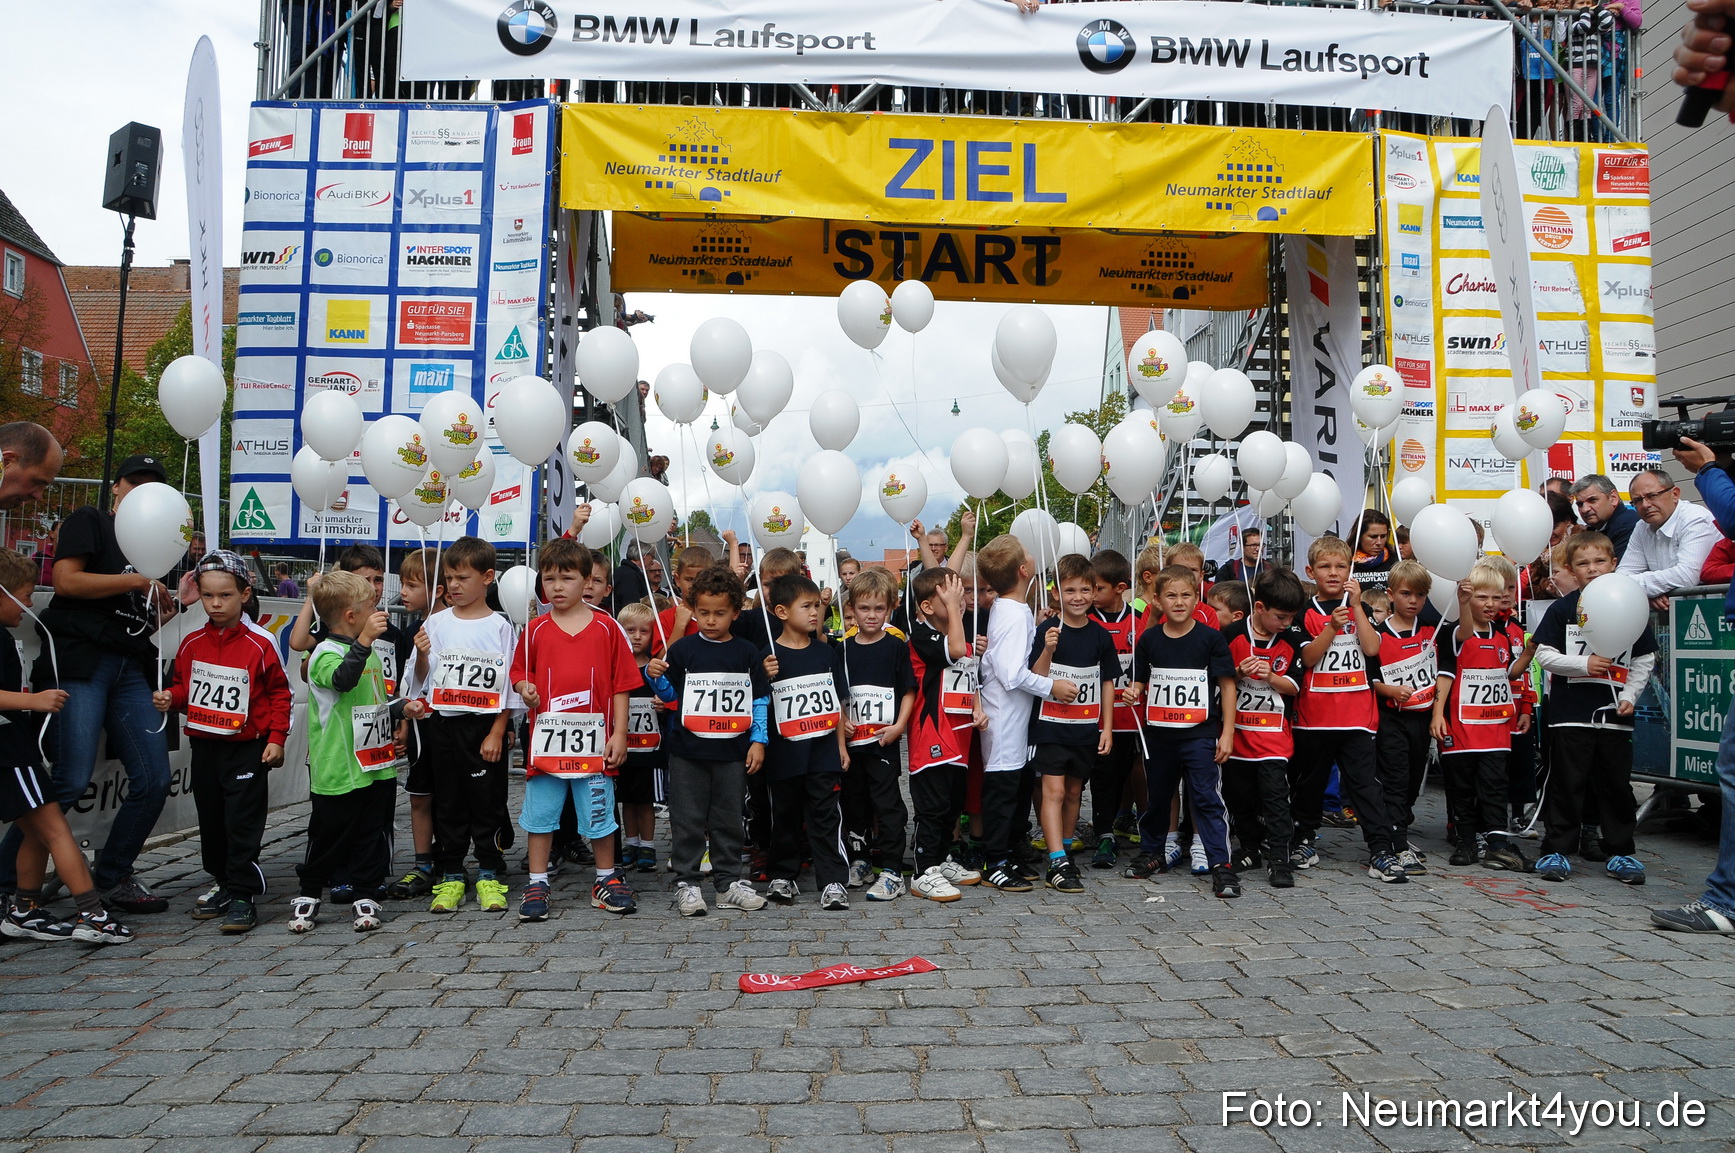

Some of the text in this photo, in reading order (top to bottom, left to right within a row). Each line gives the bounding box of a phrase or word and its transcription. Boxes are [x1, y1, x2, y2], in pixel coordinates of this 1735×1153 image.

[504, 0, 555, 21] BMW
[572, 14, 877, 56] BMW Laufsport
[1080, 20, 1130, 40] BMW
[1150, 36, 1430, 80] BMW Laufsport
[260, 140, 282, 151] DEHN
[343, 137, 371, 150] Braun
[512, 137, 532, 148] Braun
[1389, 144, 1424, 161] Xplus1
[1533, 151, 1564, 173] RUND
[1604, 157, 1622, 166] GUT
[1622, 155, 1638, 167] FÜR
[604, 161, 783, 185] Neumarkter Stadtlauf
[884, 137, 1068, 204] ZIEL
[1457, 173, 1480, 184] KAN
[1534, 172, 1569, 190] SCHAU
[253, 190, 300, 201] Bionorica
[327, 189, 379, 199] Audi BKK
[408, 188, 475, 207] Xplus1
[1165, 183, 1333, 201] Neumarkter Stadtlauf
[1400, 223, 1421, 233] KANN
[1446, 218, 1480, 227] Neumarkter
[1531, 225, 1574, 235] WITTMANN
[1623, 237, 1643, 247] DEHN
[417, 245, 472, 254] INTERSPORT
[337, 254, 384, 264] Bionorica
[406, 255, 472, 266] HACKNER
[649, 253, 793, 269] Neumarkter Stadtlauf
[833, 229, 1062, 287] START
[1403, 255, 1419, 266] maxi
[1099, 267, 1234, 284] Neumarkter Stadtlauf
[408, 303, 466, 315] GUT FÜR SIE!
[1404, 299, 1429, 308] Bionorica
[266, 314, 292, 324] Tagblatt
[329, 329, 366, 340] KANN
[1394, 332, 1431, 344] NATHUS
[1447, 336, 1492, 350] swn
[1538, 339, 1587, 355] ATHUS
[308, 376, 352, 385] GERHART
[413, 368, 449, 387] maxi
[252, 382, 292, 390] ReiseCenter
[1400, 407, 1434, 417] ACKNER
[1619, 452, 1662, 462] INTERSPOR
[1449, 457, 1516, 473] NATHUS
[1547, 467, 1573, 480] Braun
[314, 515, 363, 524] Numarkter
[375, 646, 388, 654] markt
[460, 654, 494, 665] Neumarkt
[206, 672, 240, 683] Neumarkt
[442, 662, 497, 689] 7129
[1050, 669, 1095, 680] PARTL Neumarkt
[1165, 674, 1197, 682] Neumarkt
[1383, 667, 1404, 678] PARTL
[1463, 673, 1484, 681] PARTL
[712, 679, 743, 687] Neumarkt
[1333, 674, 1351, 685] Erik
[1684, 667, 1722, 695] Fun
[773, 680, 827, 695] PARTL Neumarkt
[1079, 682, 1096, 704] 81
[1467, 682, 1509, 705] 7263
[191, 679, 242, 712] 7243
[442, 691, 489, 707] Christoph
[693, 688, 745, 713] 7152
[1153, 683, 1201, 707] 7164
[561, 696, 580, 707] DEHN
[781, 689, 834, 719] 7239
[846, 700, 884, 722] 141
[1163, 710, 1185, 721] Leon
[1480, 707, 1503, 719] Julius
[188, 709, 232, 727] sebastian
[536, 718, 596, 727] PARTL Neumarkt
[631, 712, 654, 733] 73
[1241, 714, 1260, 725] Luis
[709, 719, 731, 731] Paul
[800, 720, 827, 732] Oliver
[541, 728, 597, 753] 7131
[558, 758, 581, 772] Luis
[1684, 755, 1713, 775] Miet
